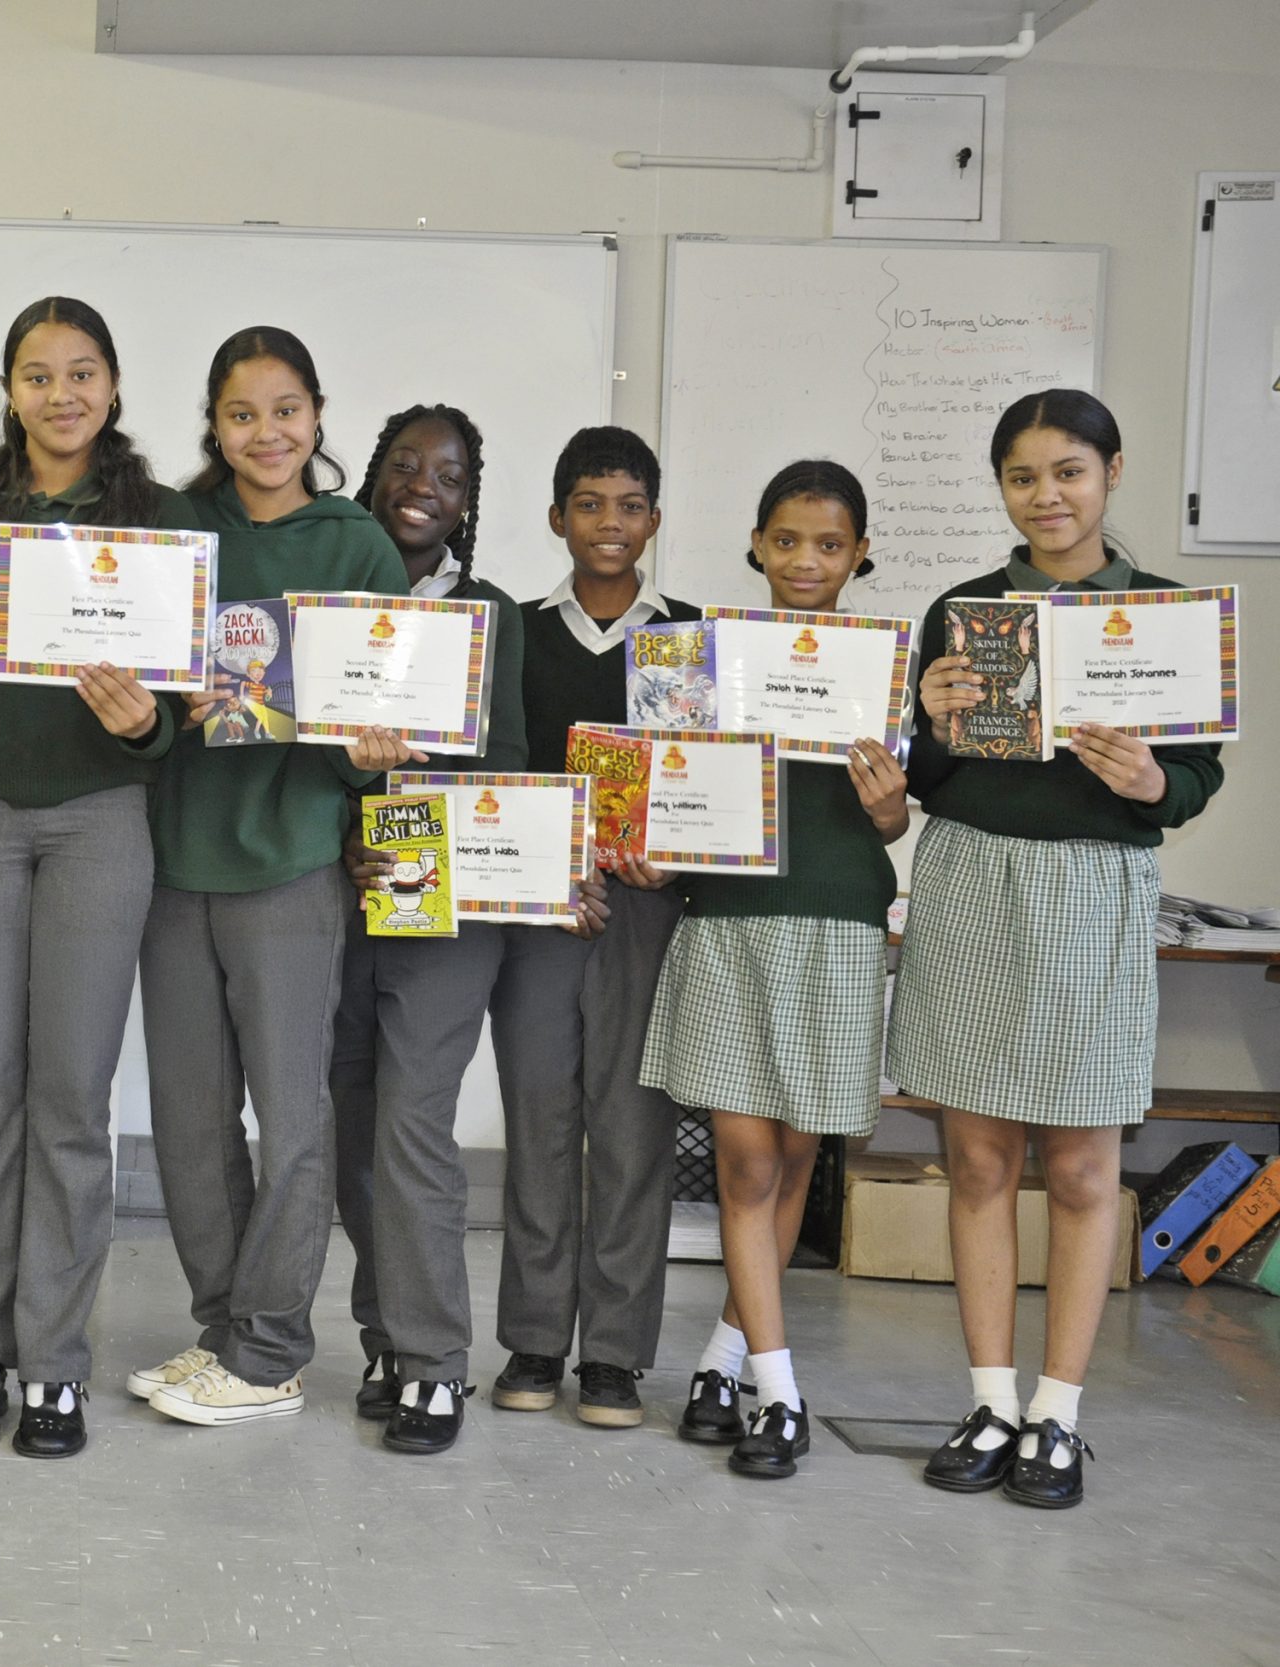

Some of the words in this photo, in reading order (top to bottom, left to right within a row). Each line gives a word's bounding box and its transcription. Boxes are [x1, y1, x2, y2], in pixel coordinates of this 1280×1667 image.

[894, 308, 917, 330] 10
[921, 308, 978, 332] Inspiring
[937, 552, 981, 565] Dance
[72, 608, 98, 617] Imrah
[224, 613, 254, 628] ZACK
[256, 617, 264, 627] IS
[225, 628, 265, 646] BACK!
[631, 630, 705, 651] Beast
[973, 640, 1011, 649] SKINFUL
[634, 647, 706, 669] Quest
[985, 651, 999, 660] OF
[972, 663, 1015, 673] SHADOWS
[1086, 670, 1127, 679] Kendrah
[1130, 668, 1177, 678] Johannes
[765, 683, 791, 692] Shiloh
[794, 685, 808, 693] Van
[811, 686, 829, 699] Wyk
[972, 715, 1018, 726] FRANCES
[970, 725, 1021, 737] HARDINGE
[575, 735, 641, 767] Beast
[574, 756, 641, 782] Quest
[369, 821, 442, 844] FAILURE
[457, 846, 490, 855] Mervedi
[495, 847, 520, 856] Waba
